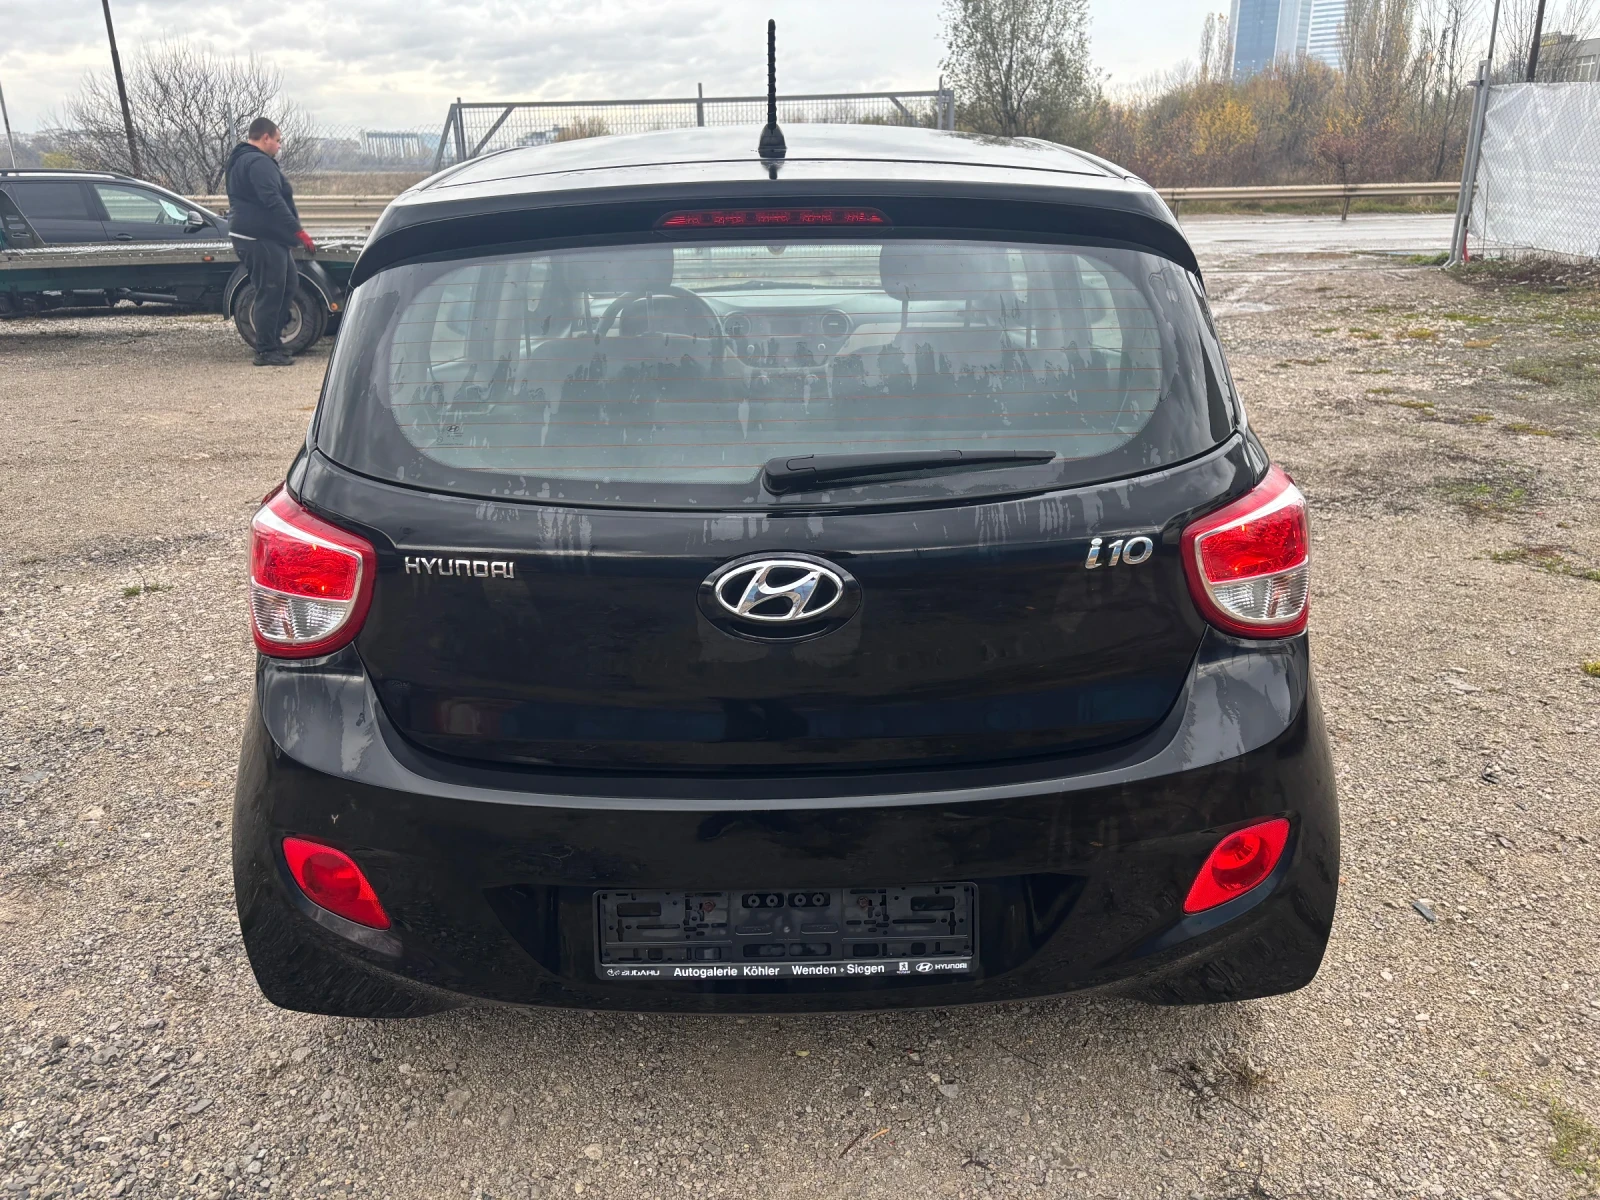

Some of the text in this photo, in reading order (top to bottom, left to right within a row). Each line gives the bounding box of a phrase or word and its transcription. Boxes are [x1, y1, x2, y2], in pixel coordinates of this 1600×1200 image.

[1084, 536, 1154, 570] i10
[404, 556, 515, 579] HYUNDAI
[673, 964, 885, 979] Autogalerie Köhler Wenden Siegen
[934, 962, 968, 970] HYUNDAI
